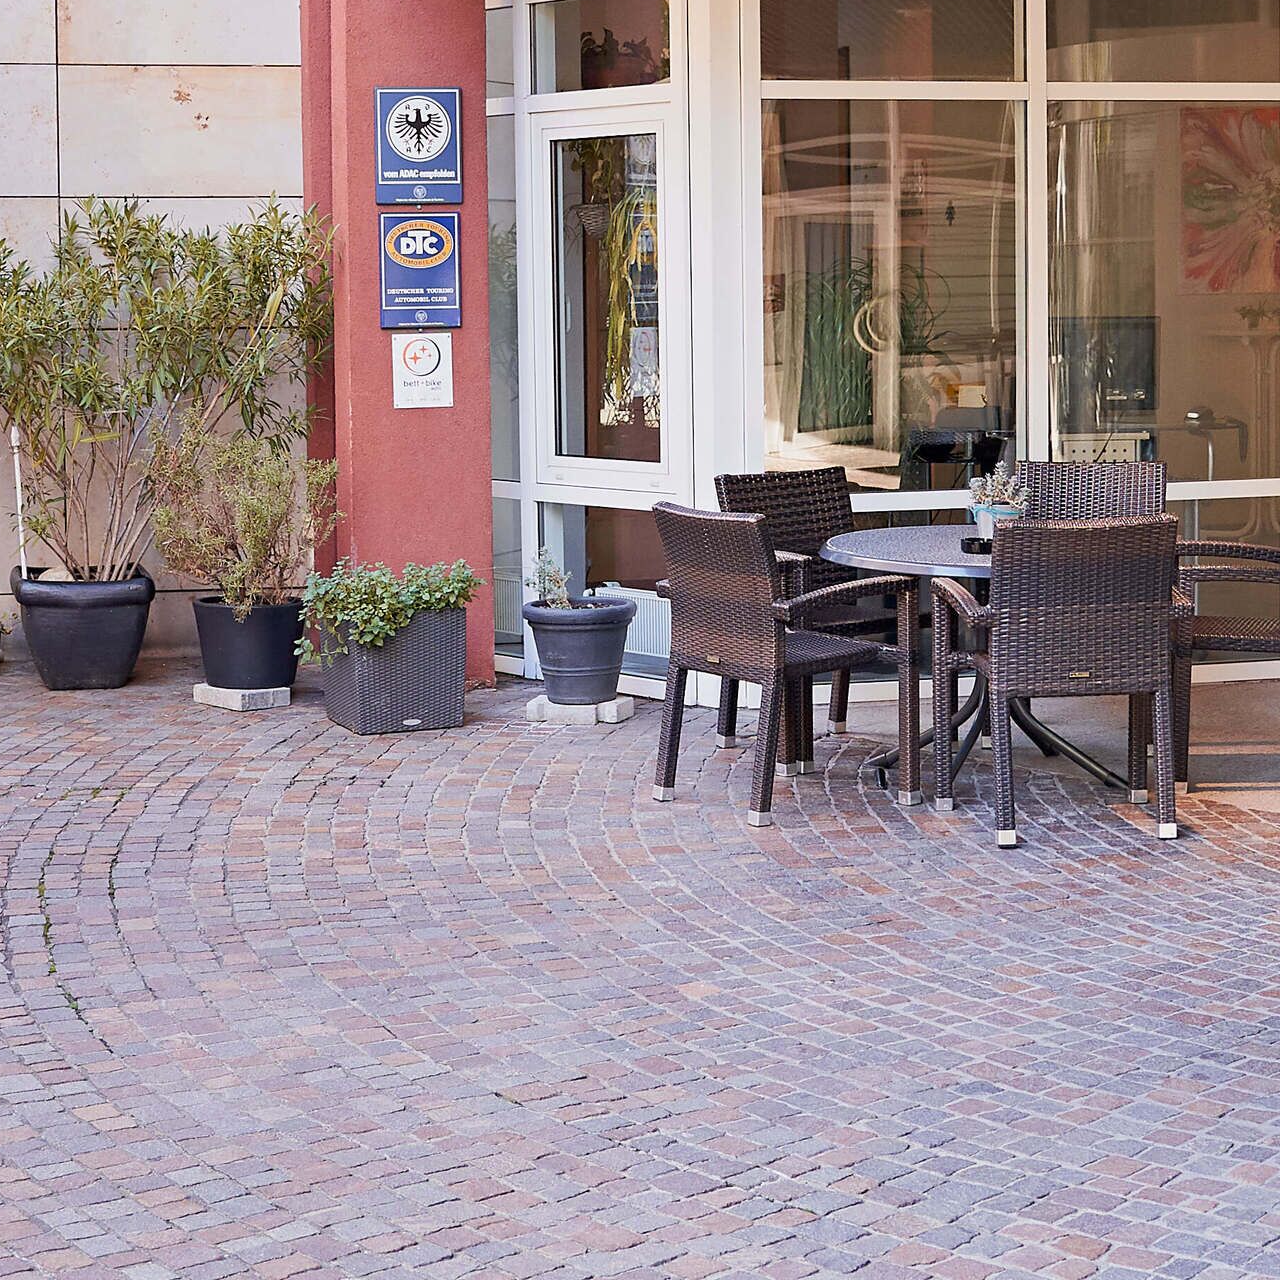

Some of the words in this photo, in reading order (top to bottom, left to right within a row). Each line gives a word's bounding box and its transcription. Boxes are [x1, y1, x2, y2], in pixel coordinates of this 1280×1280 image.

[400, 169, 419, 178] ADAC
[420, 169, 456, 180] empfohlen
[400, 230, 439, 255] DTC
